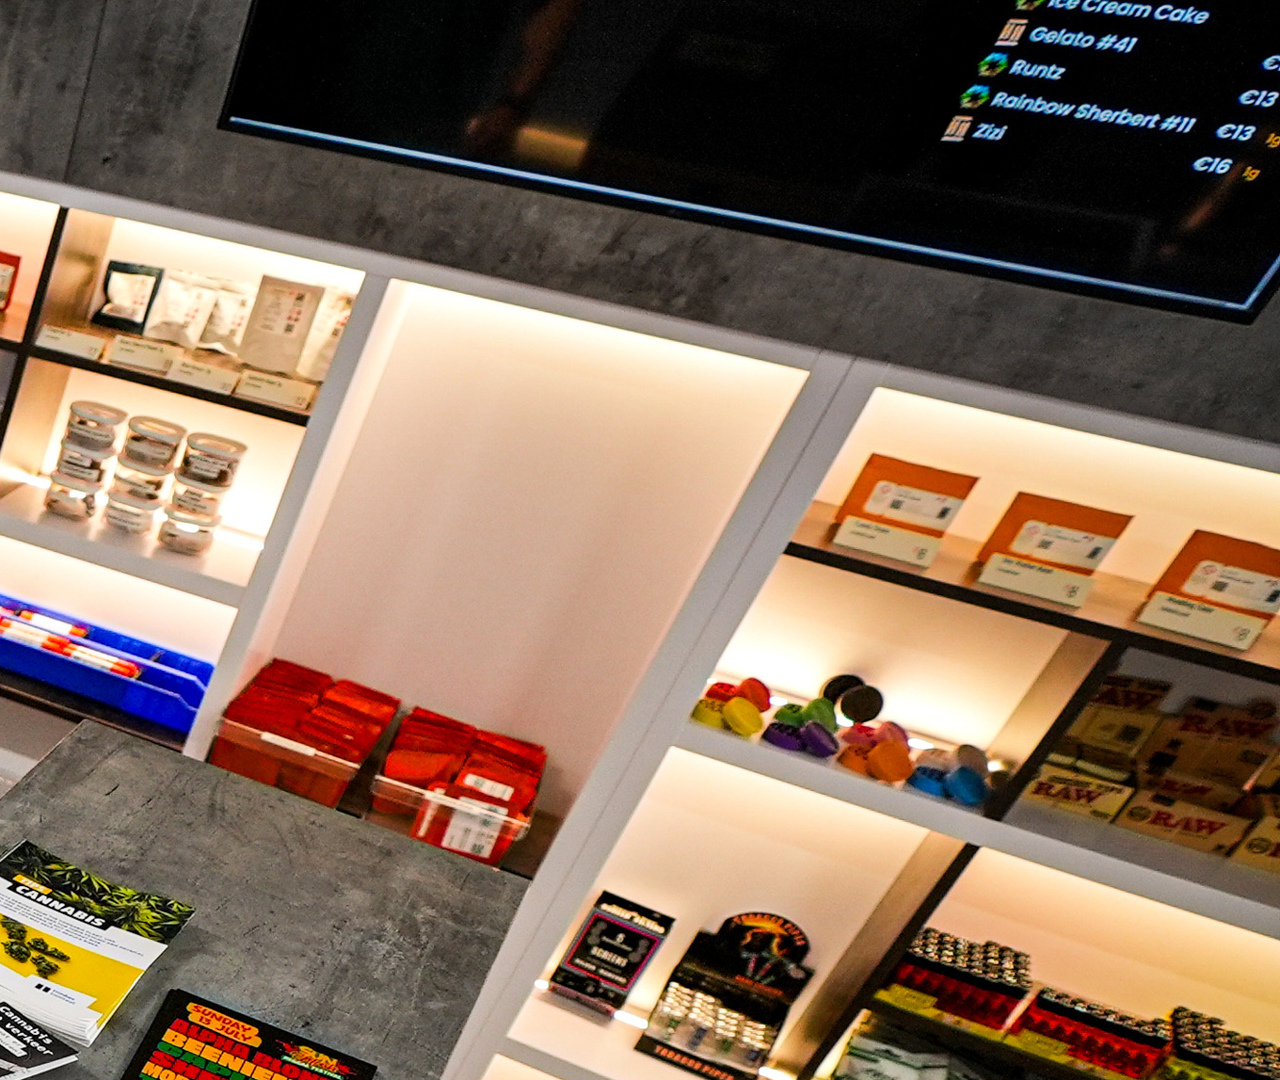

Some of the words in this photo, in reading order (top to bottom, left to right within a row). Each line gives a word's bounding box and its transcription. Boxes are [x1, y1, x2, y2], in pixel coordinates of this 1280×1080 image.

[1081, 0, 1152, 18] Cream
[1154, 5, 1210, 24] Cake
[1028, 26, 1095, 48] Gelato
[1096, 35, 1138, 53] #41
[1009, 59, 1066, 80] Runtz
[1239, 89, 1279, 107] €13
[990, 91, 1075, 117] Rainbow
[1074, 103, 1160, 130] Sherbert
[1158, 115, 1197, 134] #11
[1216, 123, 1256, 141] €13
[971, 122, 1008, 141] Zizi
[1193, 156, 1233, 174] €16
[15, 885, 107, 928] CANNABIS
[0, 1006, 54, 1046] Cannabis
[5, 1022, 54, 1056] verkeer
[169, 1018, 250, 1060] ALPHA
[192, 1005, 252, 1033] SUNDAY
[216, 1024, 252, 1042] JULY
